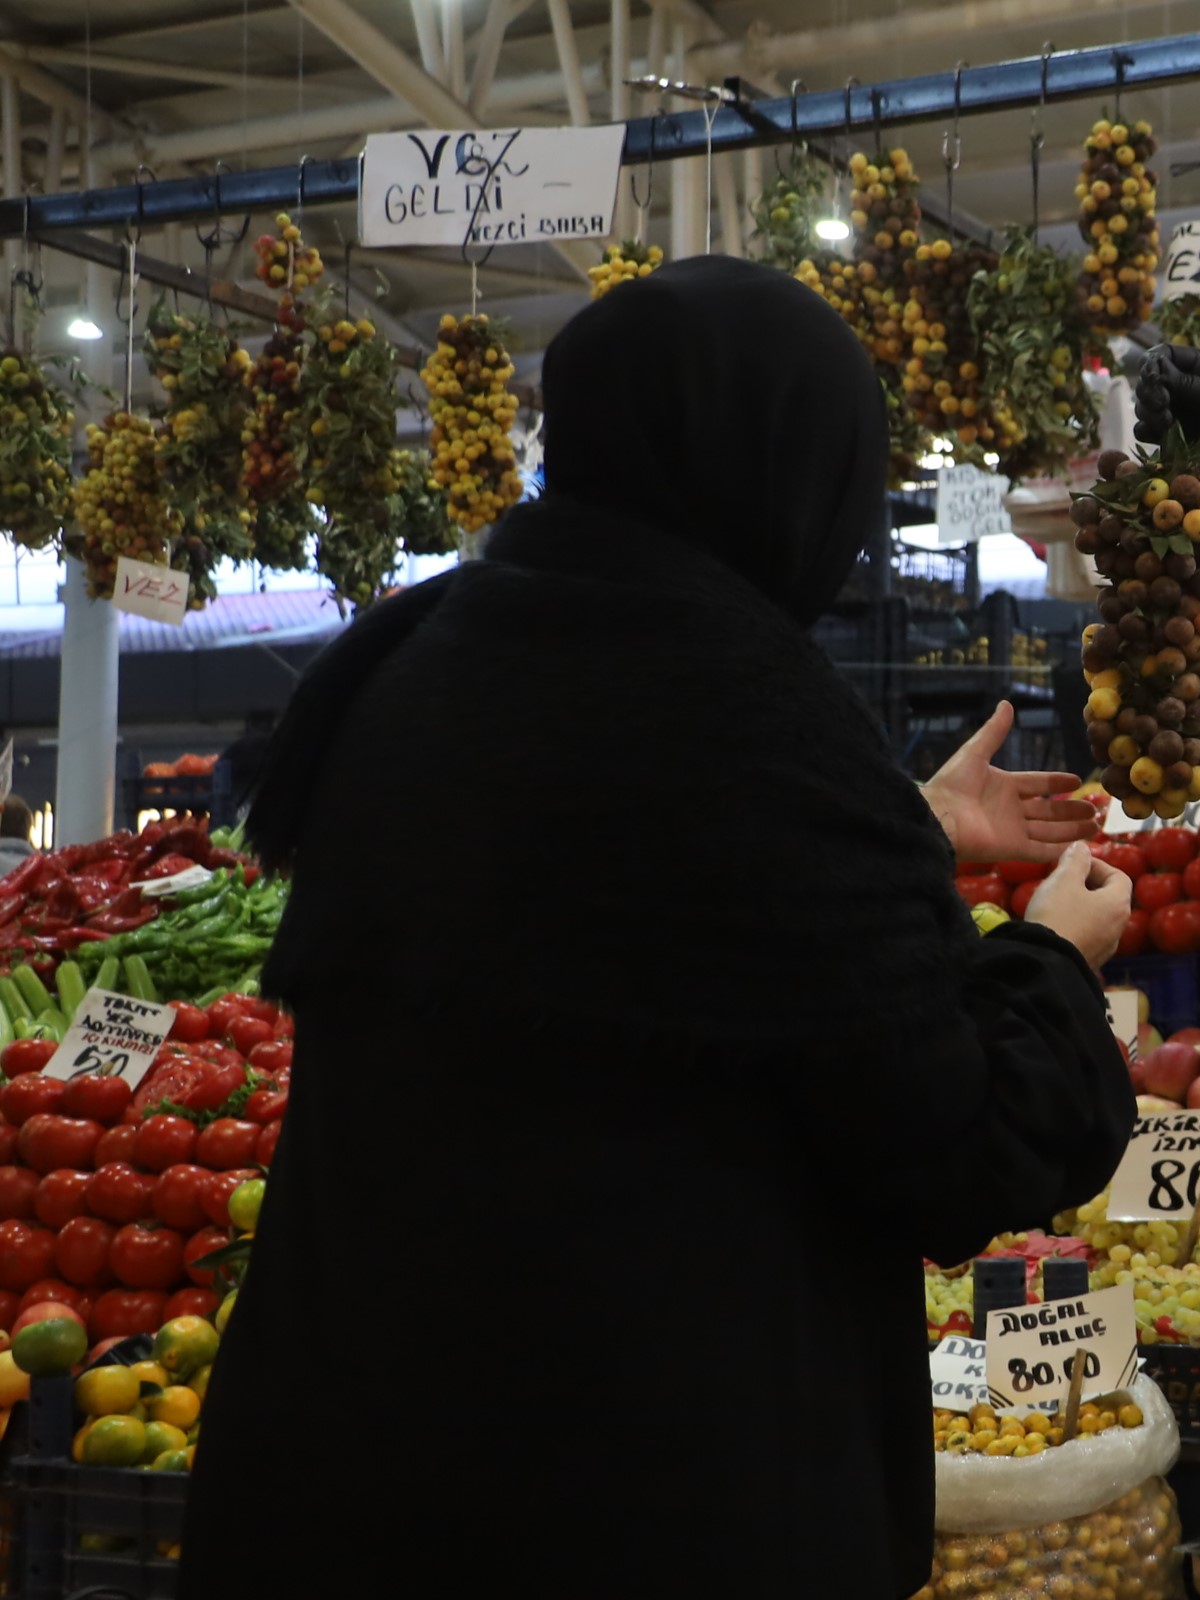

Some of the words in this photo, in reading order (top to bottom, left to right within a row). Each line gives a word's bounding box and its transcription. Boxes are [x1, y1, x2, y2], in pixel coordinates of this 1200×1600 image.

[539, 215, 604, 236] BABA
[994, 1301, 1090, 1337] DOĞAL
[1039, 1318, 1107, 1347] ALUÇ
[1007, 1352, 1102, 1392] 80,00
